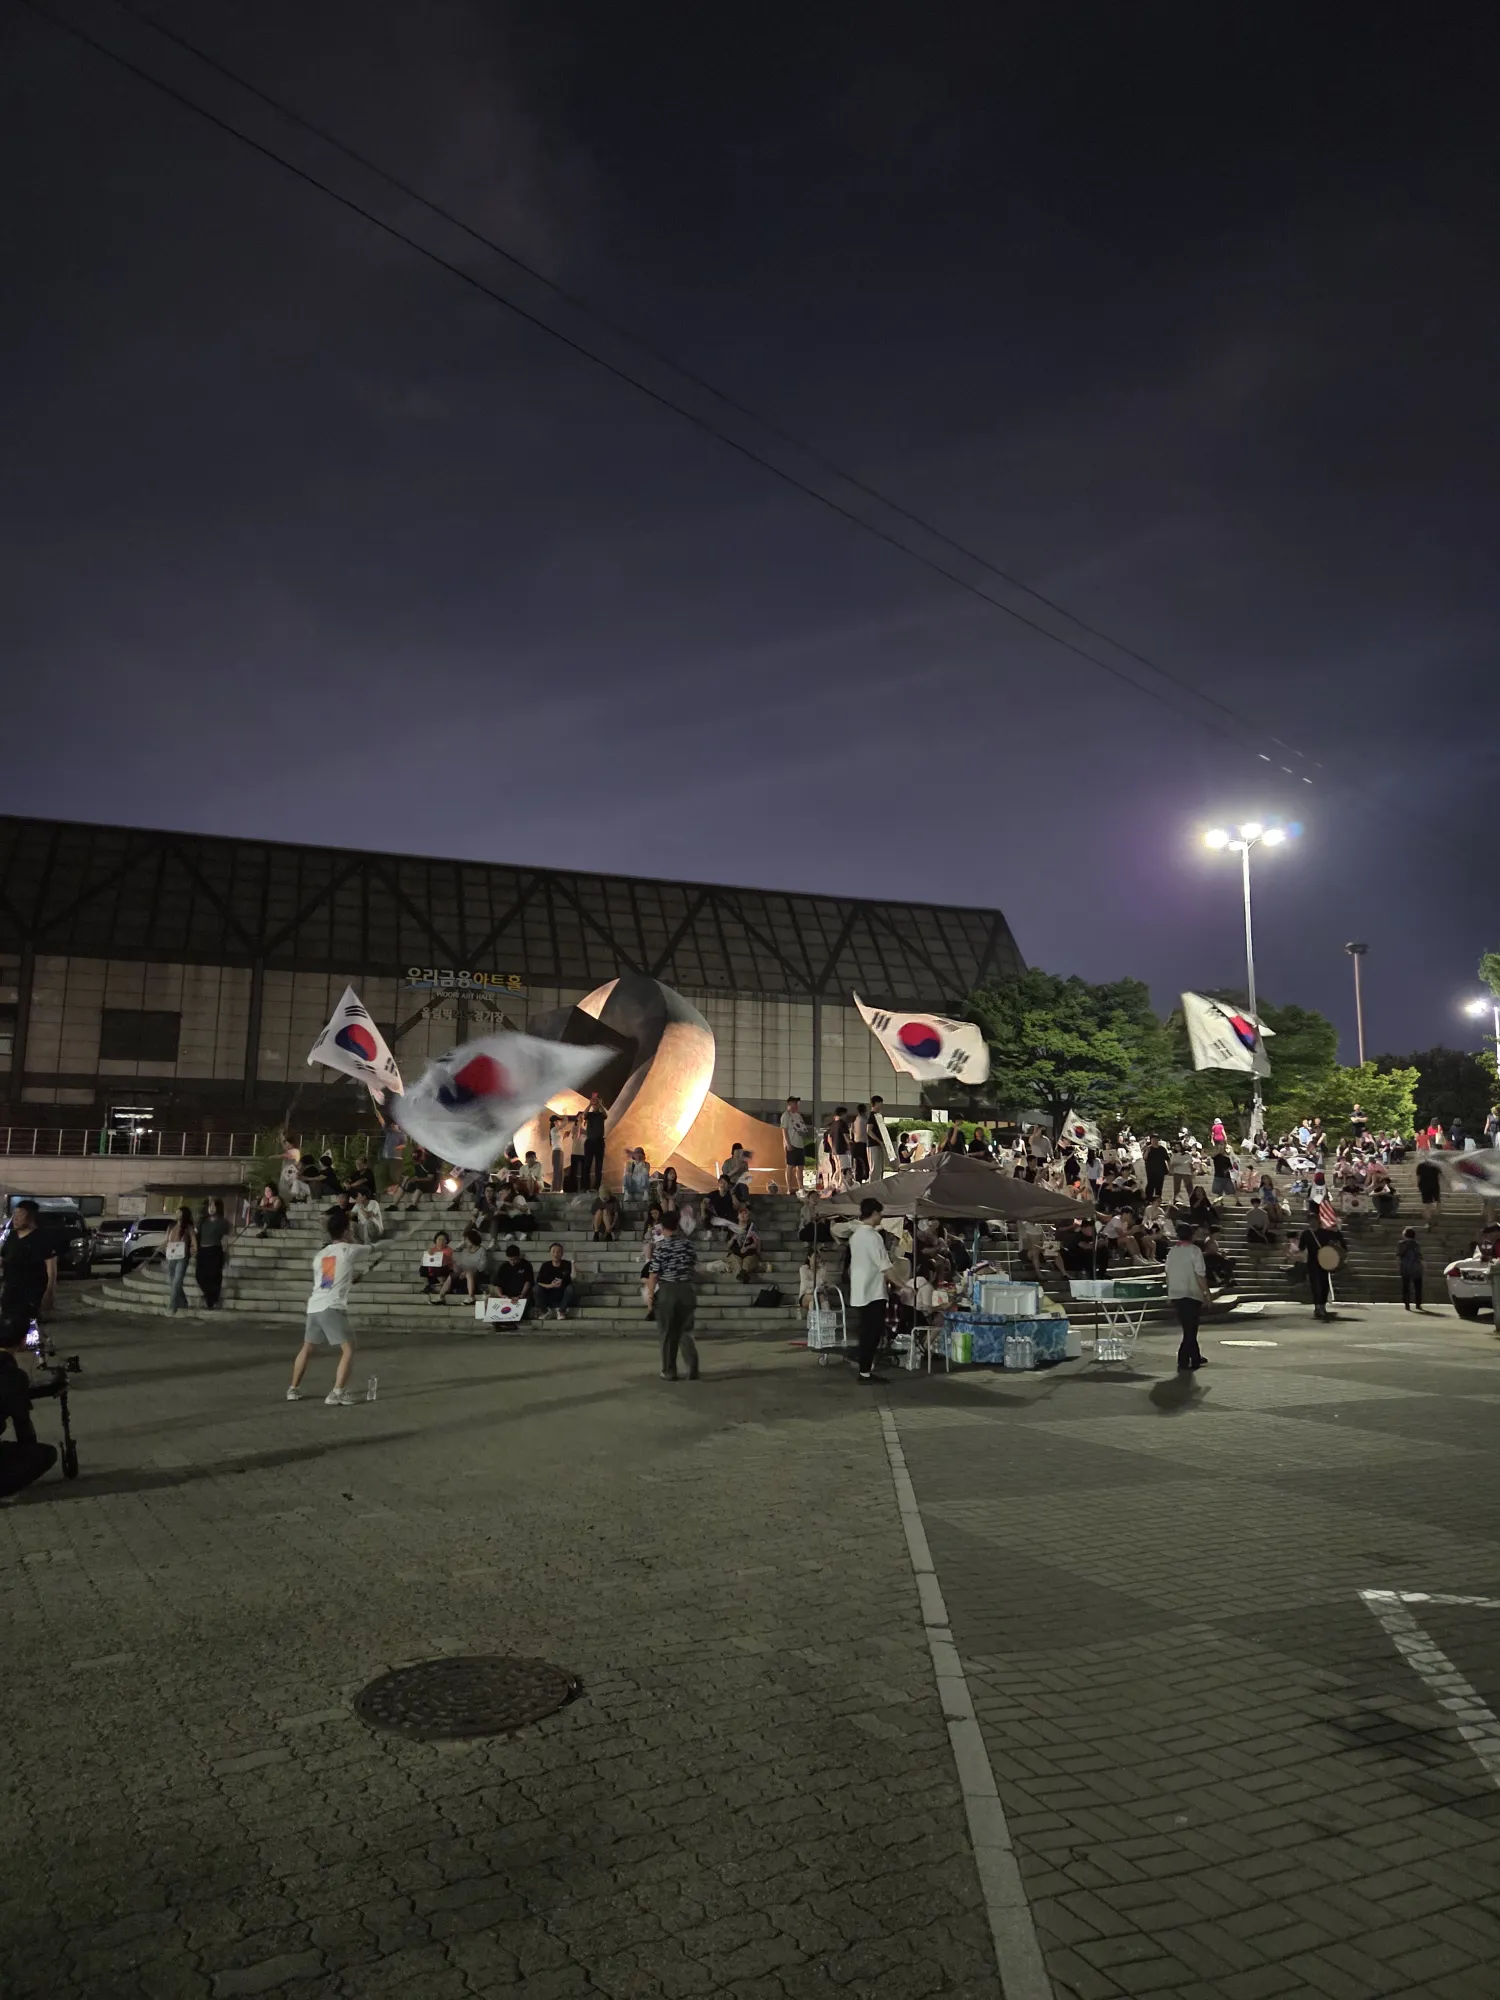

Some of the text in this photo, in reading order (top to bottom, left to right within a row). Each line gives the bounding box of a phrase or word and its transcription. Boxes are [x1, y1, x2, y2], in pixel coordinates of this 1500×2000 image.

[406, 967, 523, 991] 우리금융아트홀
[436, 991, 493, 1001] WOORI ART HALL
